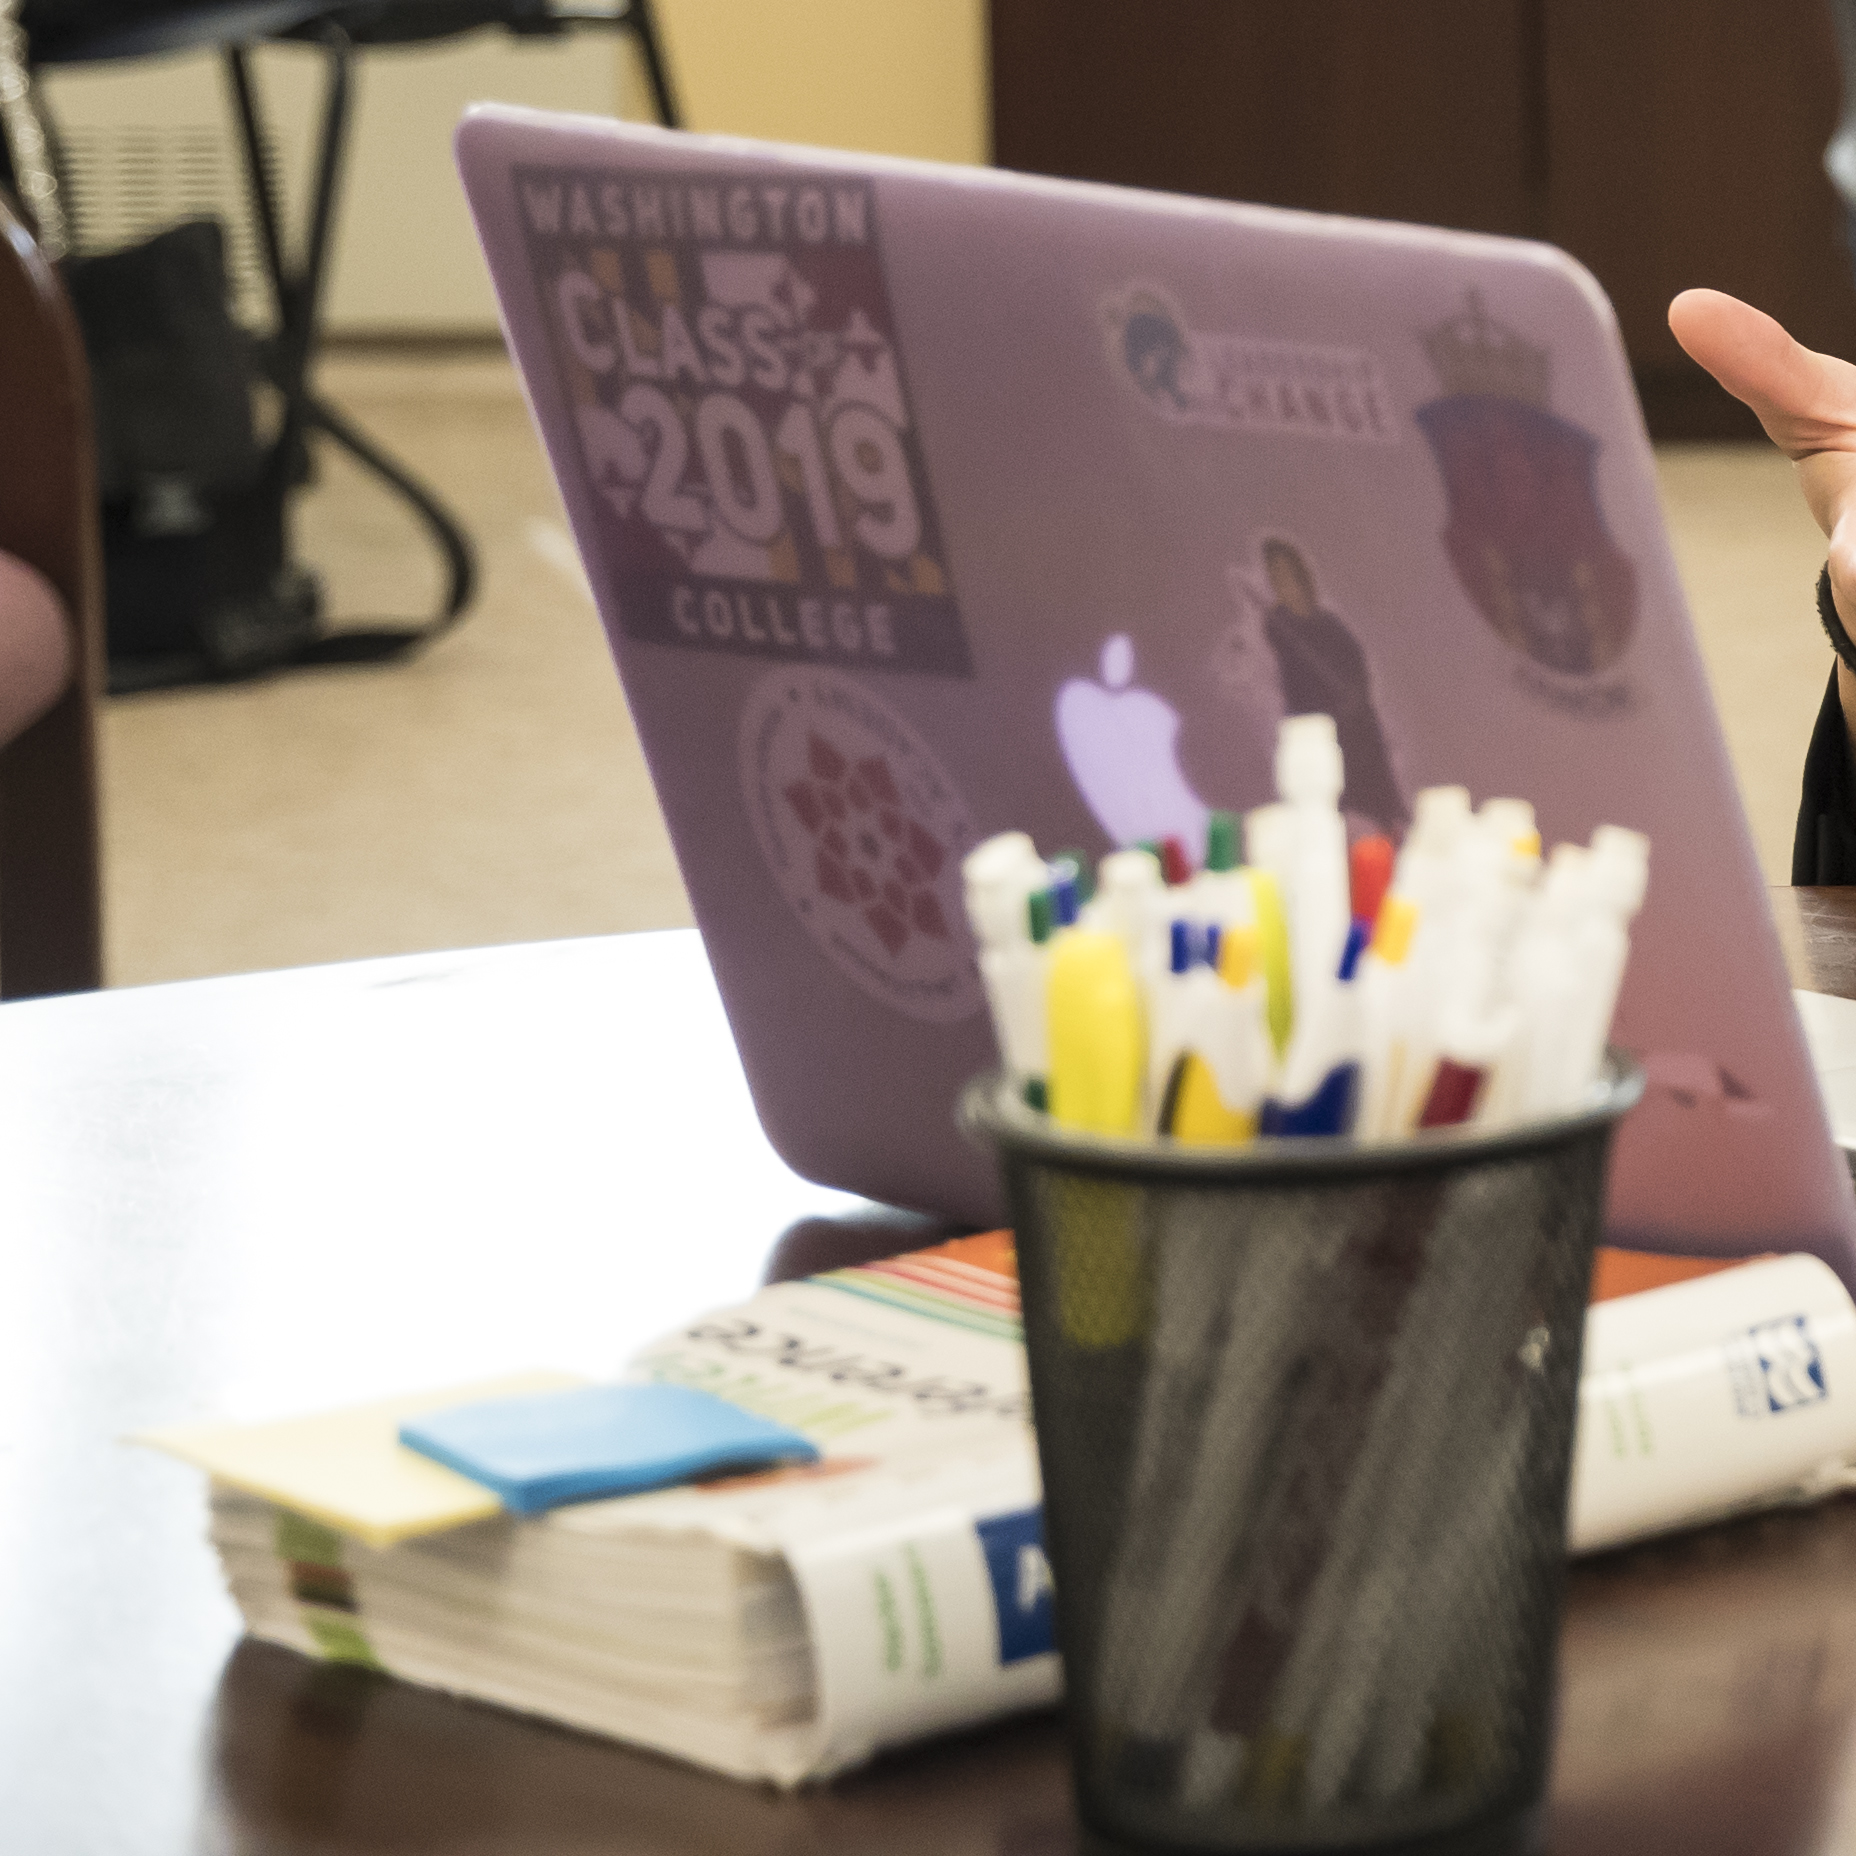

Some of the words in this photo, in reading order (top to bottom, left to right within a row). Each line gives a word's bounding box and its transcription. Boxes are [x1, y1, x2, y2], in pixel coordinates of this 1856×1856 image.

[519, 181, 868, 242] WASHINGTON
[556, 270, 790, 392] CLASS
[618, 381, 923, 560] 2019
[673, 586, 897, 656] COLLEGE
